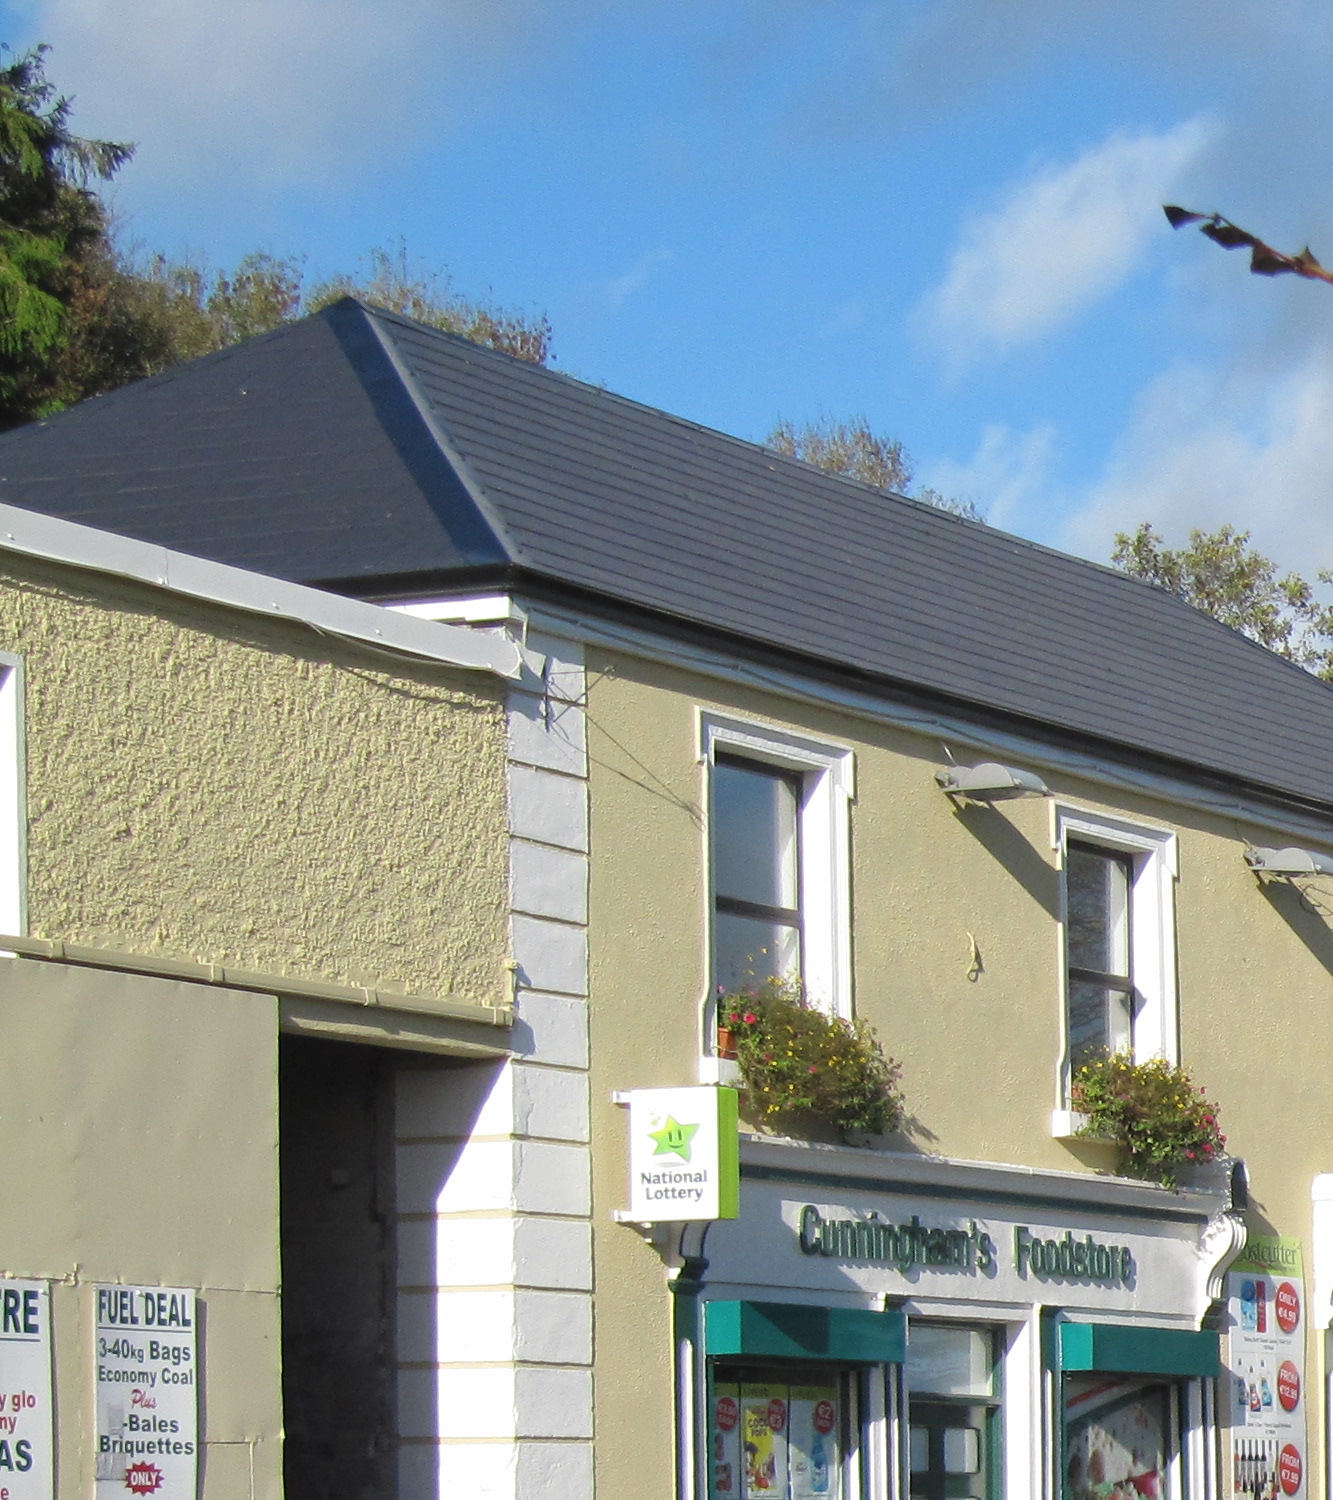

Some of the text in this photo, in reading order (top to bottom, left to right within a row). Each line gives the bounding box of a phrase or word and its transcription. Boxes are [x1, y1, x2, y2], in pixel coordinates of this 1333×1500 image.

[641, 1170, 708, 1185] National
[645, 1186, 703, 1202] Lottery
[800, 1204, 1133, 1282] Cunningham's Foodstore
[0, 1290, 39, 1334] RE
[98, 1290, 192, 1327] FUEL DEAL
[100, 1337, 191, 1365] 3-40kg Bags
[98, 1365, 193, 1388] Economy Coal
[12, 1391, 36, 1412] glo
[131, 1388, 157, 1409] Plus
[100, 1435, 194, 1457] Briquettes
[130, 1471, 158, 1486] ONLY
